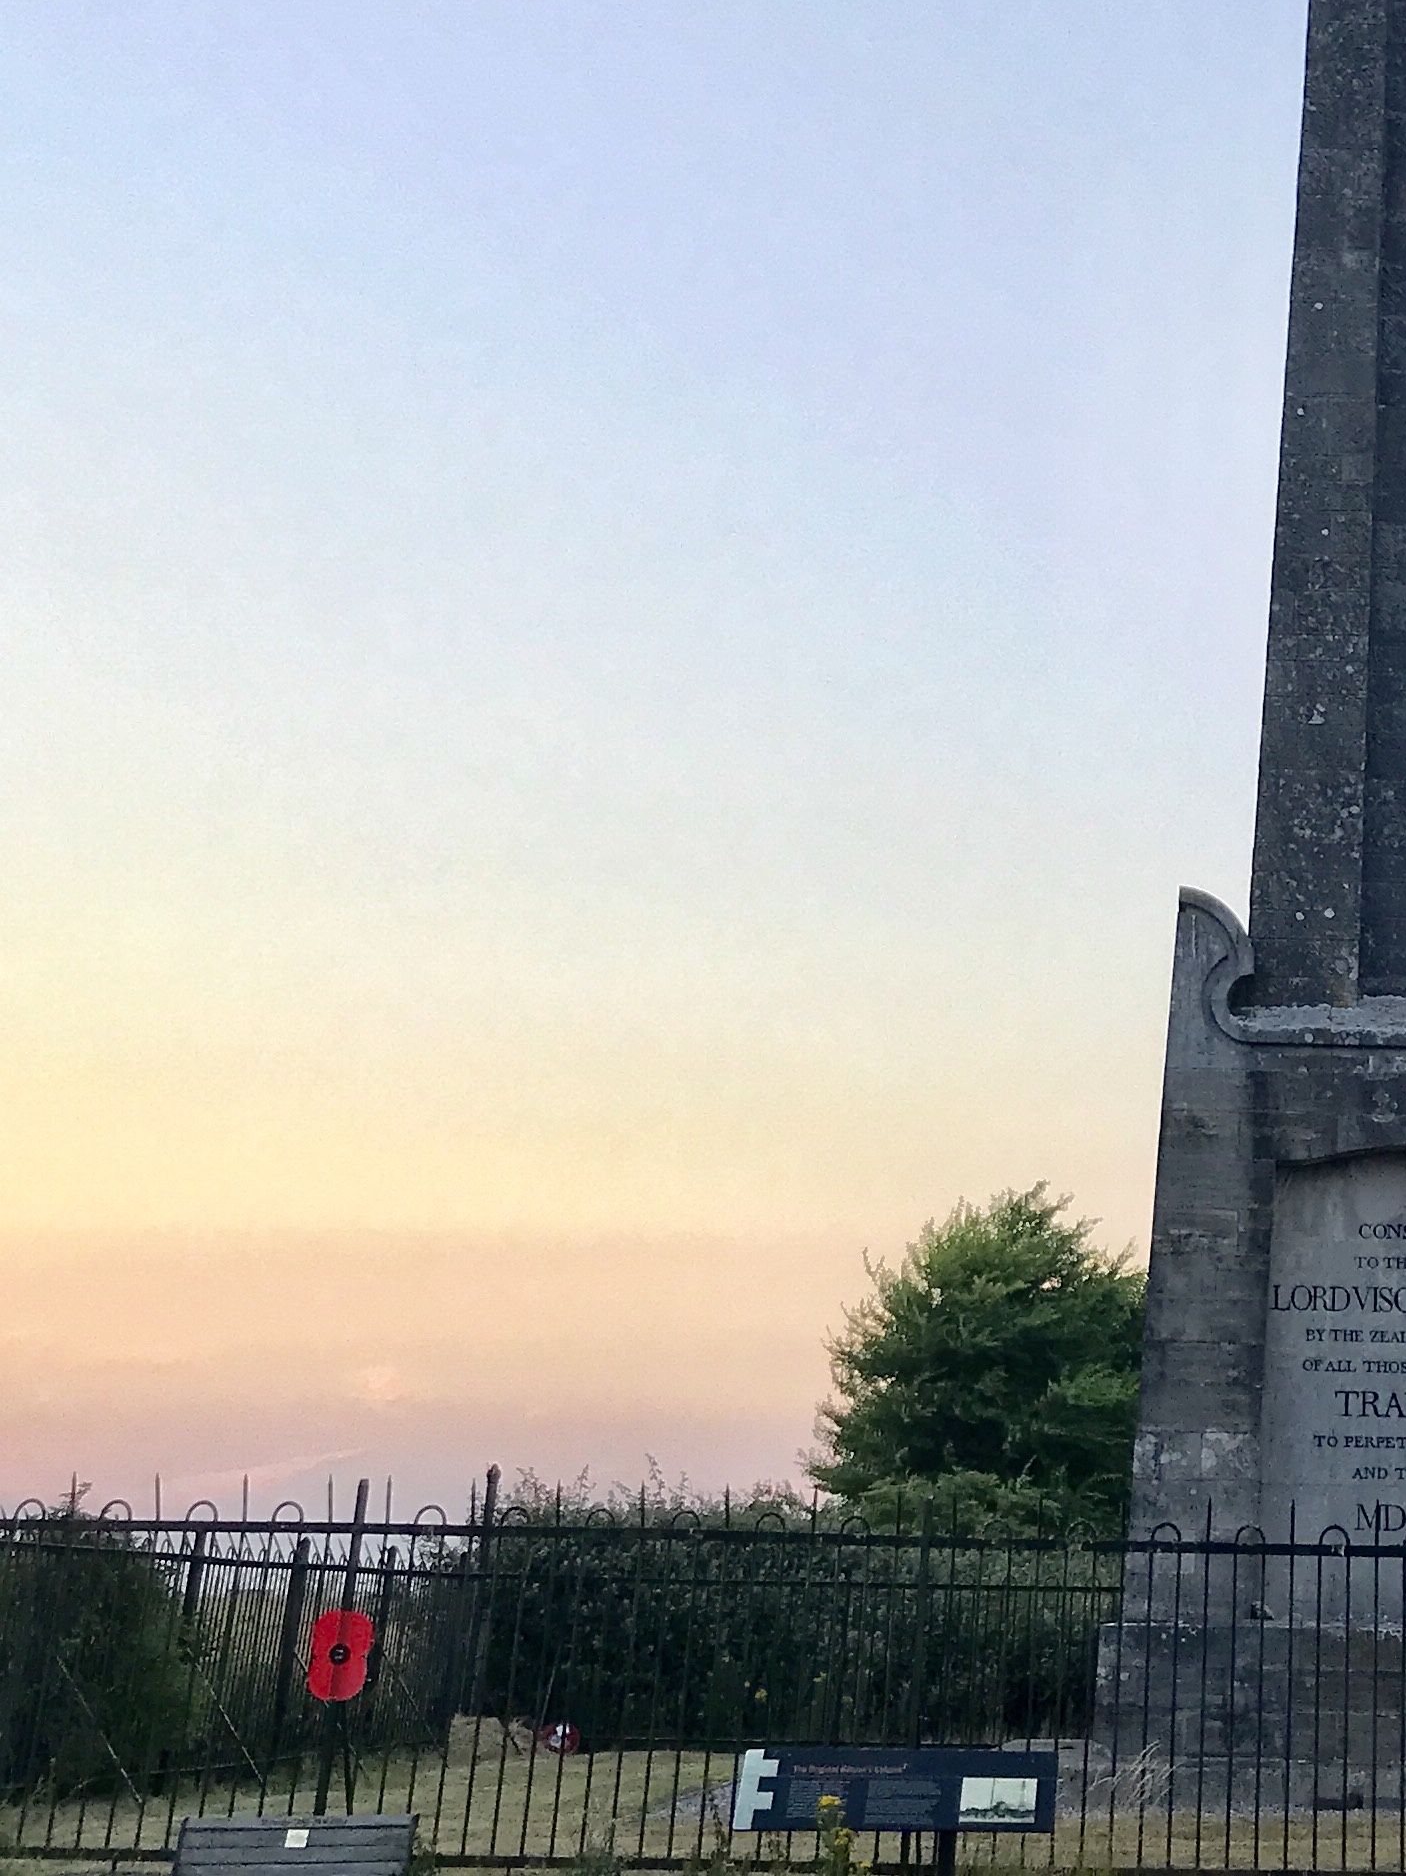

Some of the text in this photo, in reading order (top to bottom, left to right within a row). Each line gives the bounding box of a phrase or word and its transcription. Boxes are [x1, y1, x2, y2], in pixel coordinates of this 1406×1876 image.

[1355, 1257, 1378, 1270] TO
[1270, 1285, 1350, 1311] LORD
[1306, 1329, 1327, 1342] BY
[1329, 1329, 1364, 1343] THE
[1303, 1359, 1324, 1372] OF
[1324, 1360, 1356, 1373] ALL
[1313, 1435, 1338, 1447] TO
[1352, 1467, 1388, 1480] AND
